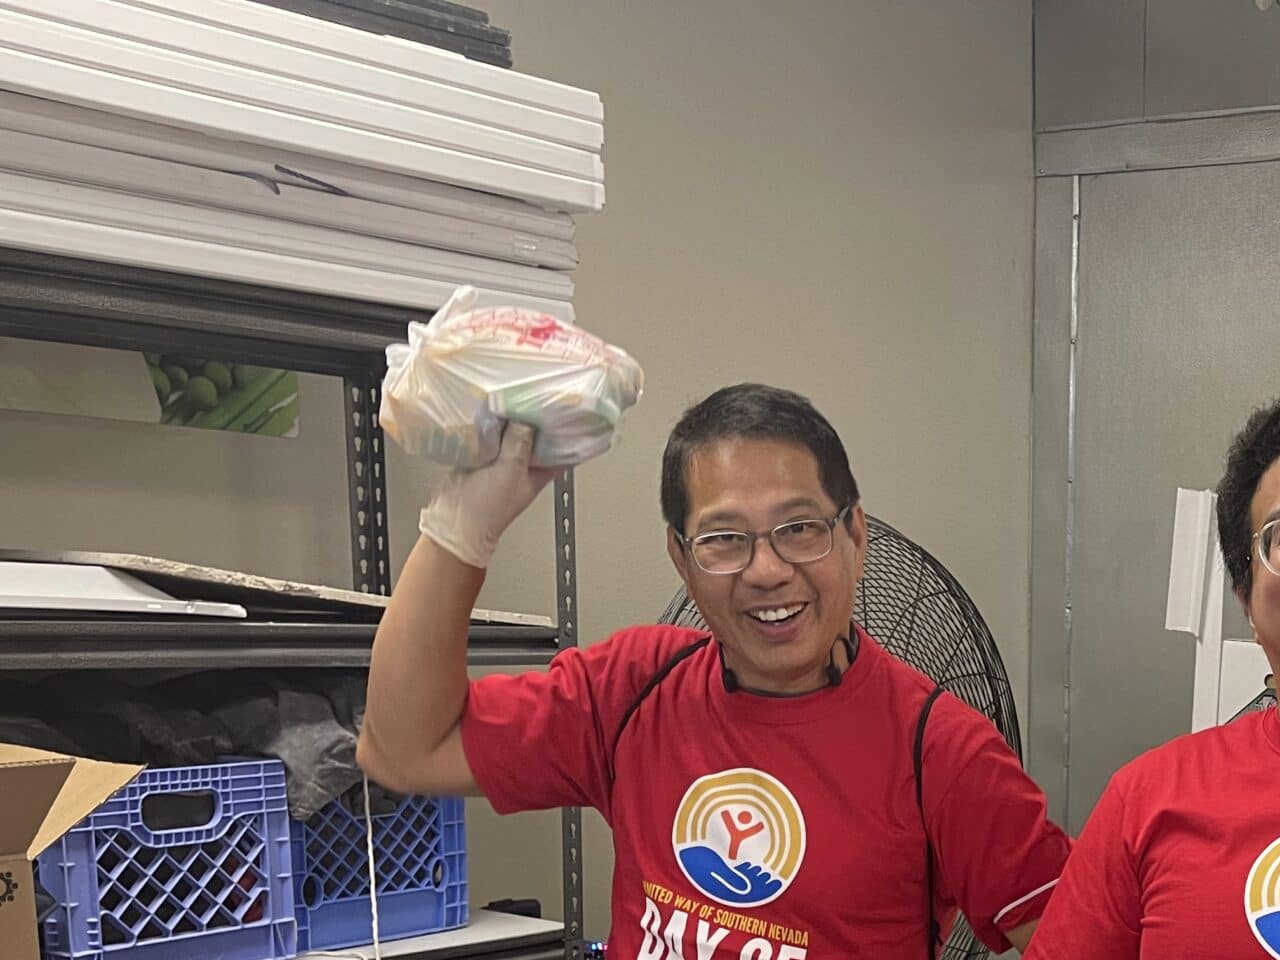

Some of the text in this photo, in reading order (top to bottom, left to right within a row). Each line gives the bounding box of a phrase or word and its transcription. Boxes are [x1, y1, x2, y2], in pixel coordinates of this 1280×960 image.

[643, 882, 809, 946] UNITED WAY OF SOUTHERN NEVADA
